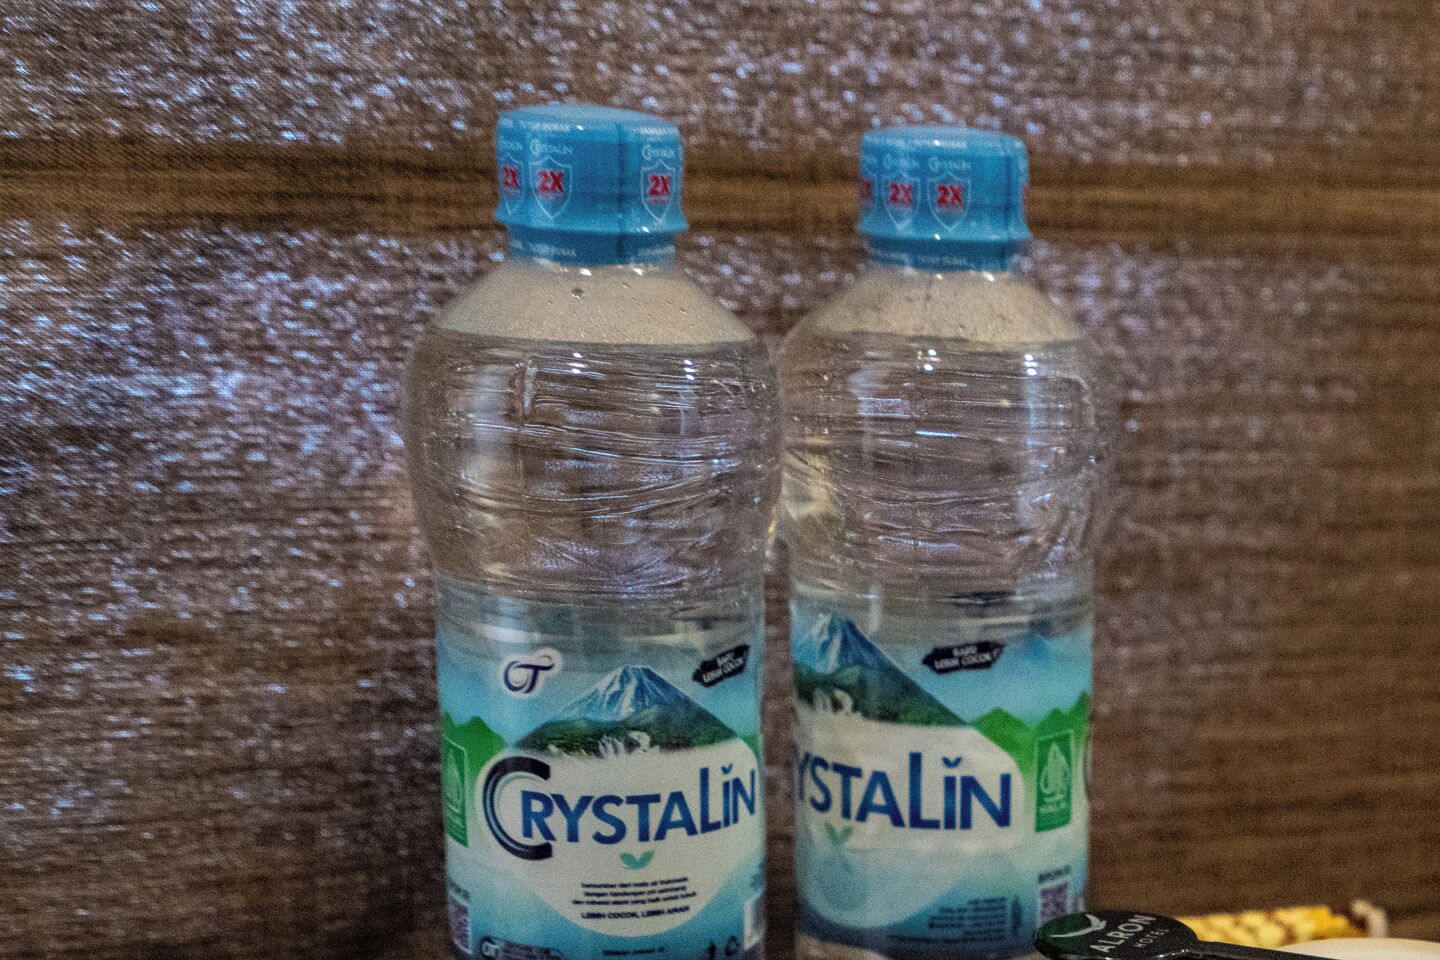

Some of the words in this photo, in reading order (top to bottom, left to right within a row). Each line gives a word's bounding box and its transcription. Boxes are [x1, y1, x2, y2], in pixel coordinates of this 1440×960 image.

[537, 170, 564, 193] 2X
[648, 175, 670, 196] 2X
[936, 183, 963, 208] 2X
[1089, 914, 1157, 953] ALRON
